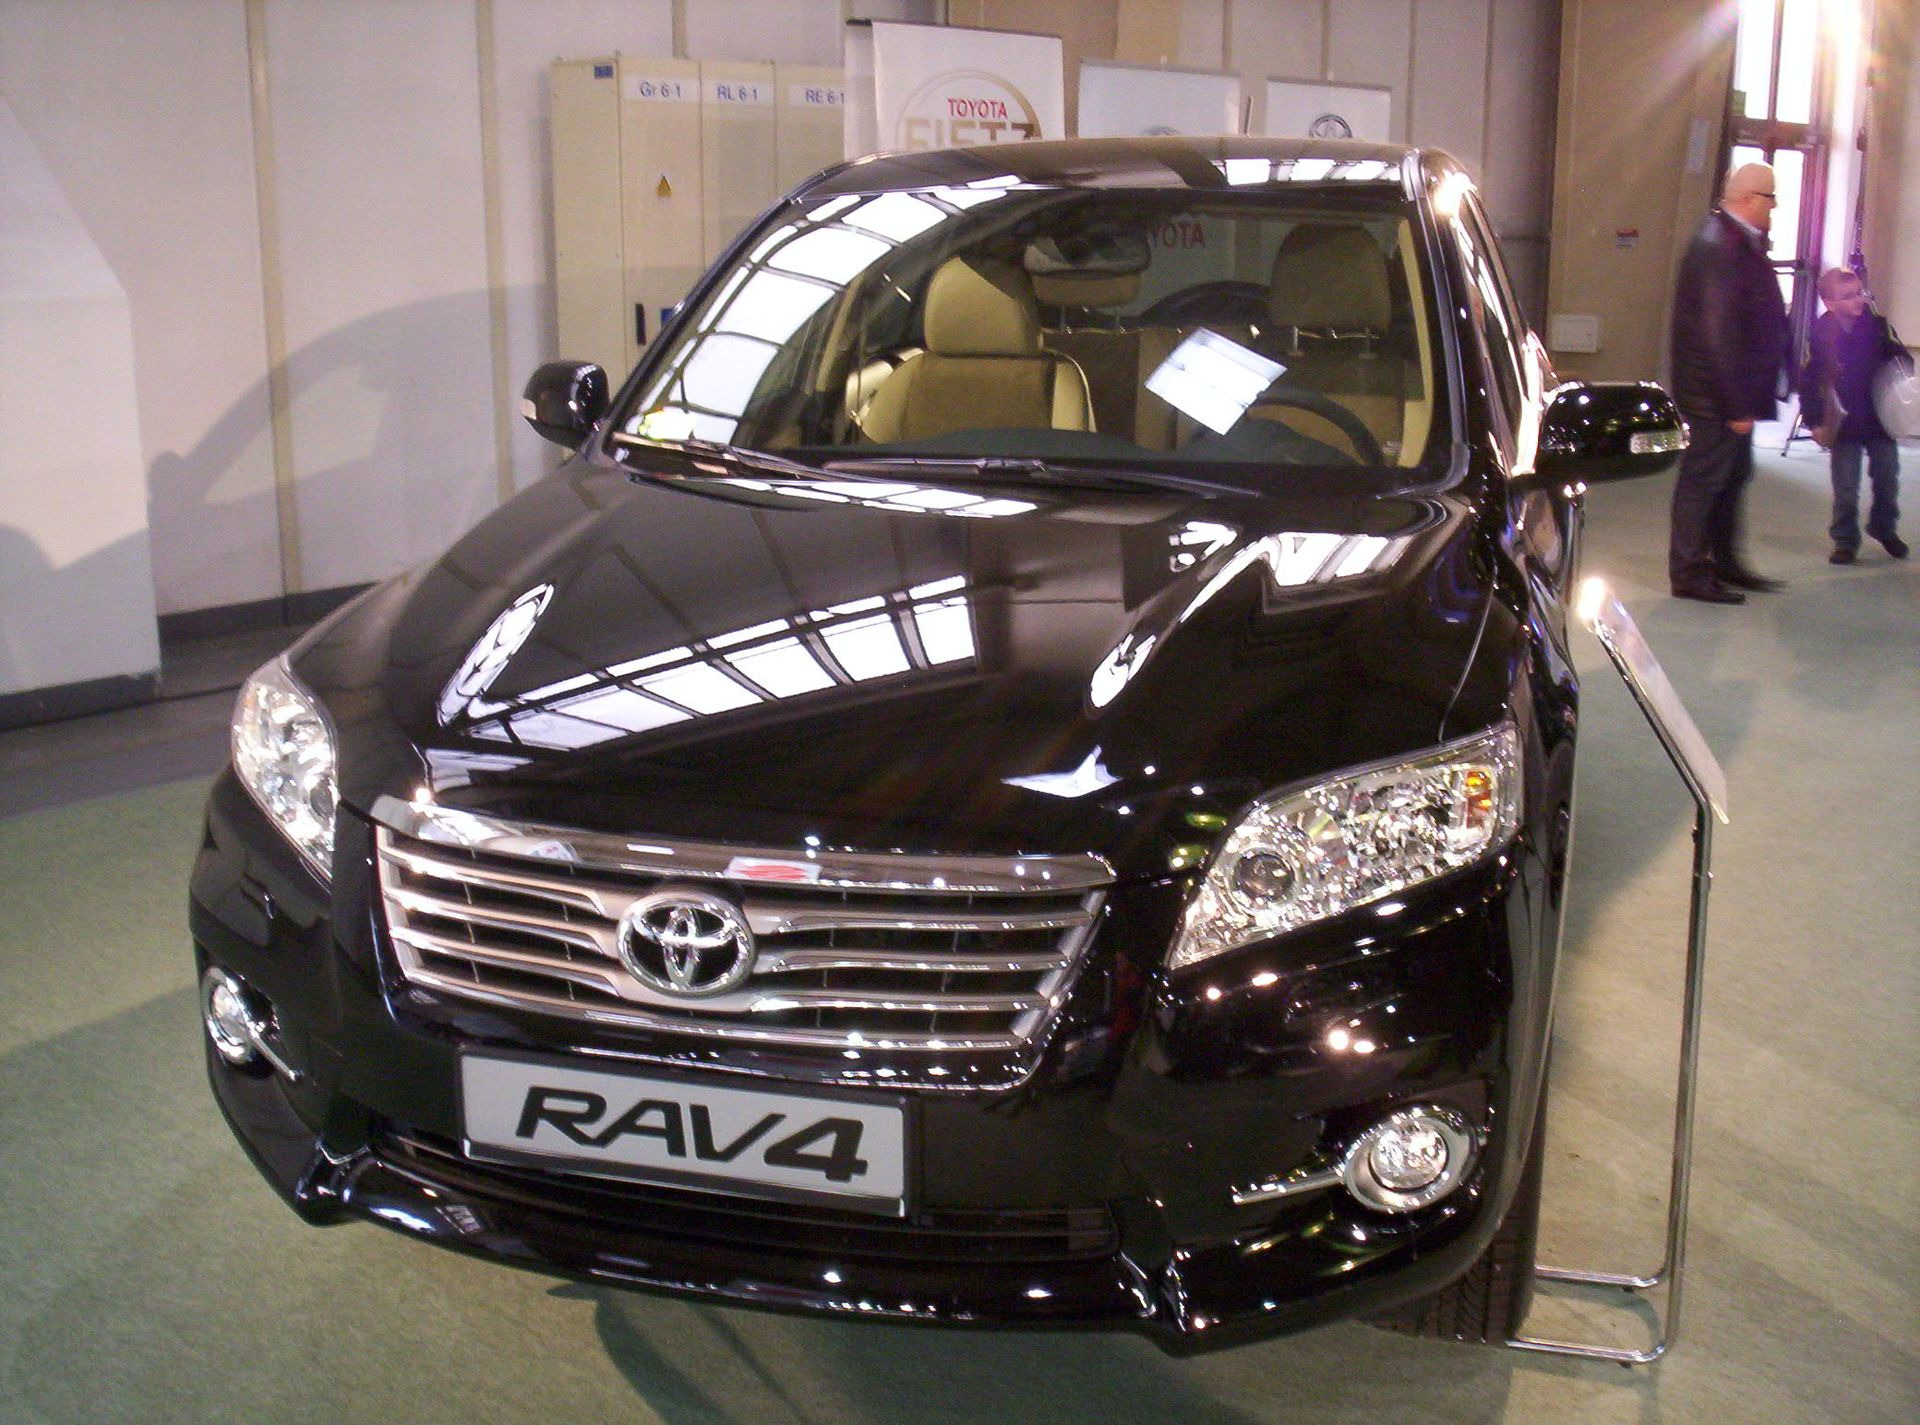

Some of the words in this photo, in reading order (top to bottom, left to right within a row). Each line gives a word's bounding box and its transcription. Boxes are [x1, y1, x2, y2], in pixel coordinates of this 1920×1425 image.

[716, 85, 735, 101] RL
[804, 88, 824, 104] RE
[946, 96, 1008, 120] TOYOTA
[1149, 221, 1206, 249] YOTA
[514, 1085, 869, 1183] RAV4
